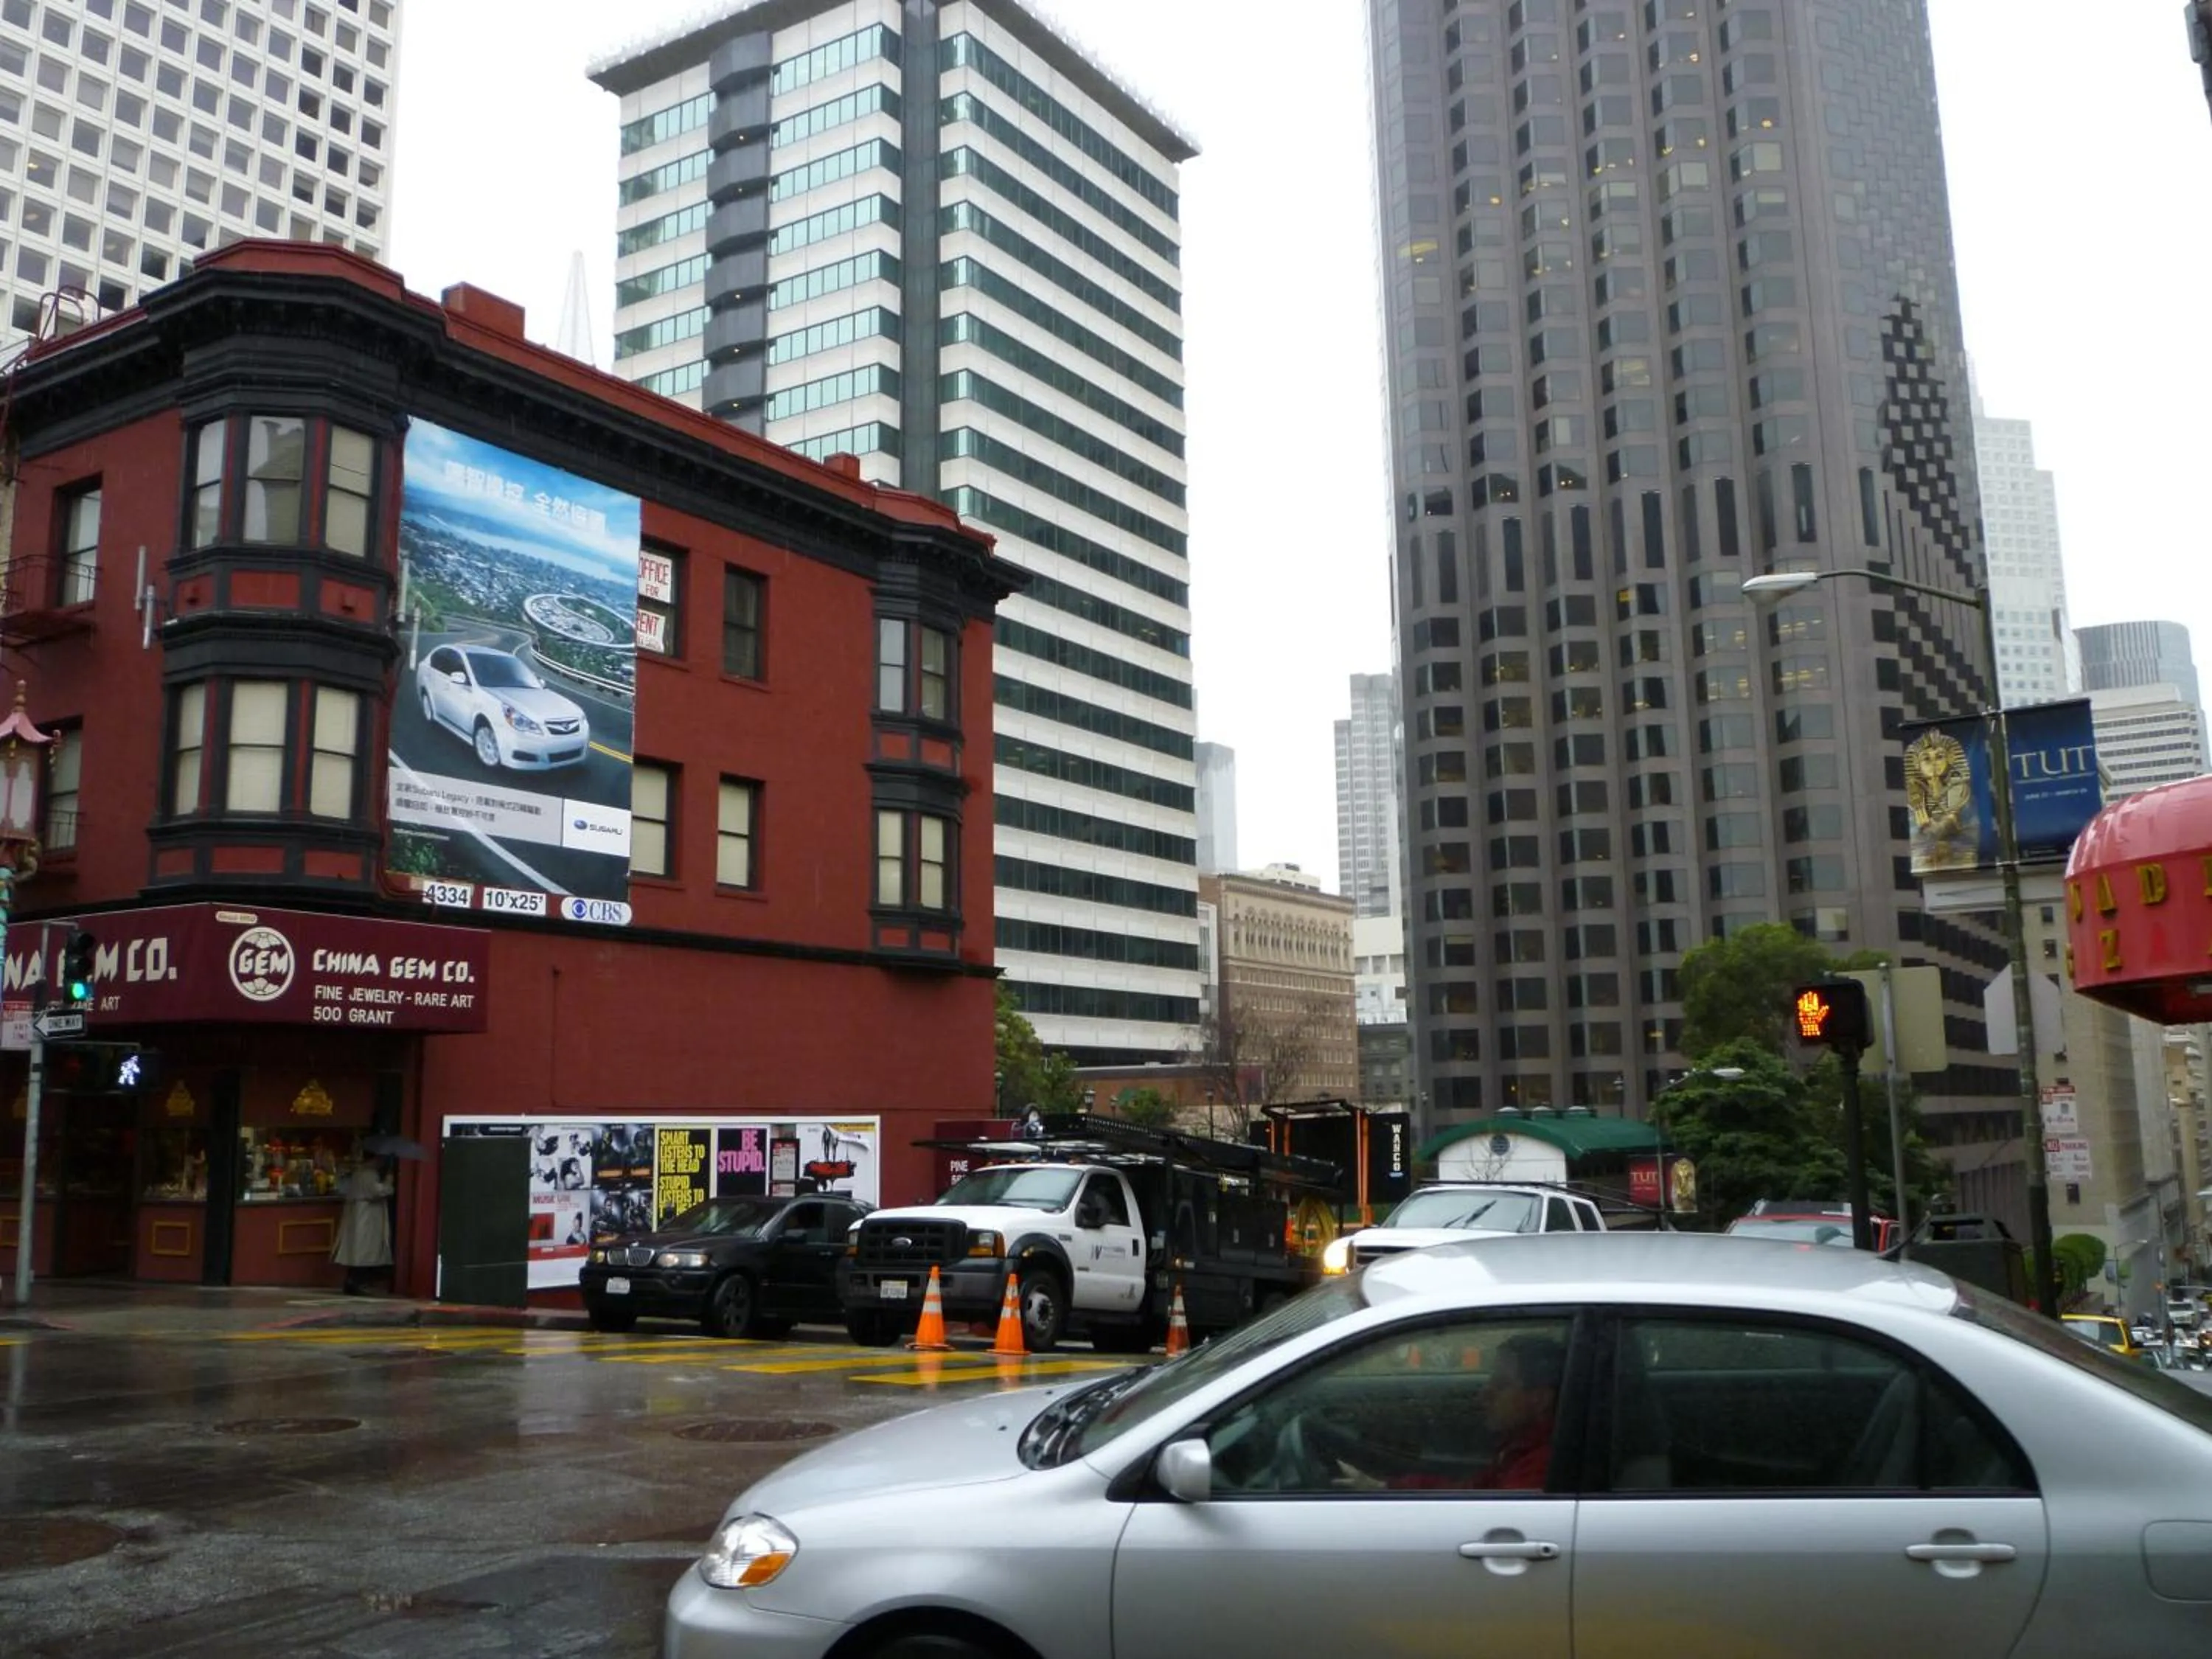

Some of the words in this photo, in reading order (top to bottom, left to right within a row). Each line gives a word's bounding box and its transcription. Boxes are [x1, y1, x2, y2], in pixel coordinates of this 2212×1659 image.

[646, 584, 660, 597] FOR
[2011, 745, 2093, 777] TUT
[425, 884, 468, 905] 4334
[589, 900, 622, 922] CBS
[126, 936, 178, 982] CO.
[238, 948, 288, 975] GEM
[312, 949, 381, 975] CHINA
[389, 956, 437, 979] GEM
[442, 961, 475, 984] CO.
[100, 995, 121, 1012] ART
[315, 984, 343, 1001] FINE
[349, 987, 405, 1004] JEWELRY
[414, 992, 447, 1007] RARE
[451, 994, 476, 1009] ART
[49, 1018, 62, 1030] ONE
[313, 1006, 342, 1022] 500
[349, 1008, 395, 1025] GRANT
[660, 1130, 690, 1145] SMART
[742, 1129, 758, 1151] BE
[661, 1144, 692, 1159] LISTENS
[695, 1144, 706, 1160] TO
[718, 1150, 766, 1172] STUPID.
[660, 1158, 675, 1173] THE
[676, 1158, 700, 1173] HEAD
[659, 1175, 690, 1189] STUPID
[1630, 1171, 1658, 1184] TUT
[659, 1189, 692, 1204] LISTENS
[693, 1188, 704, 1206] TO
